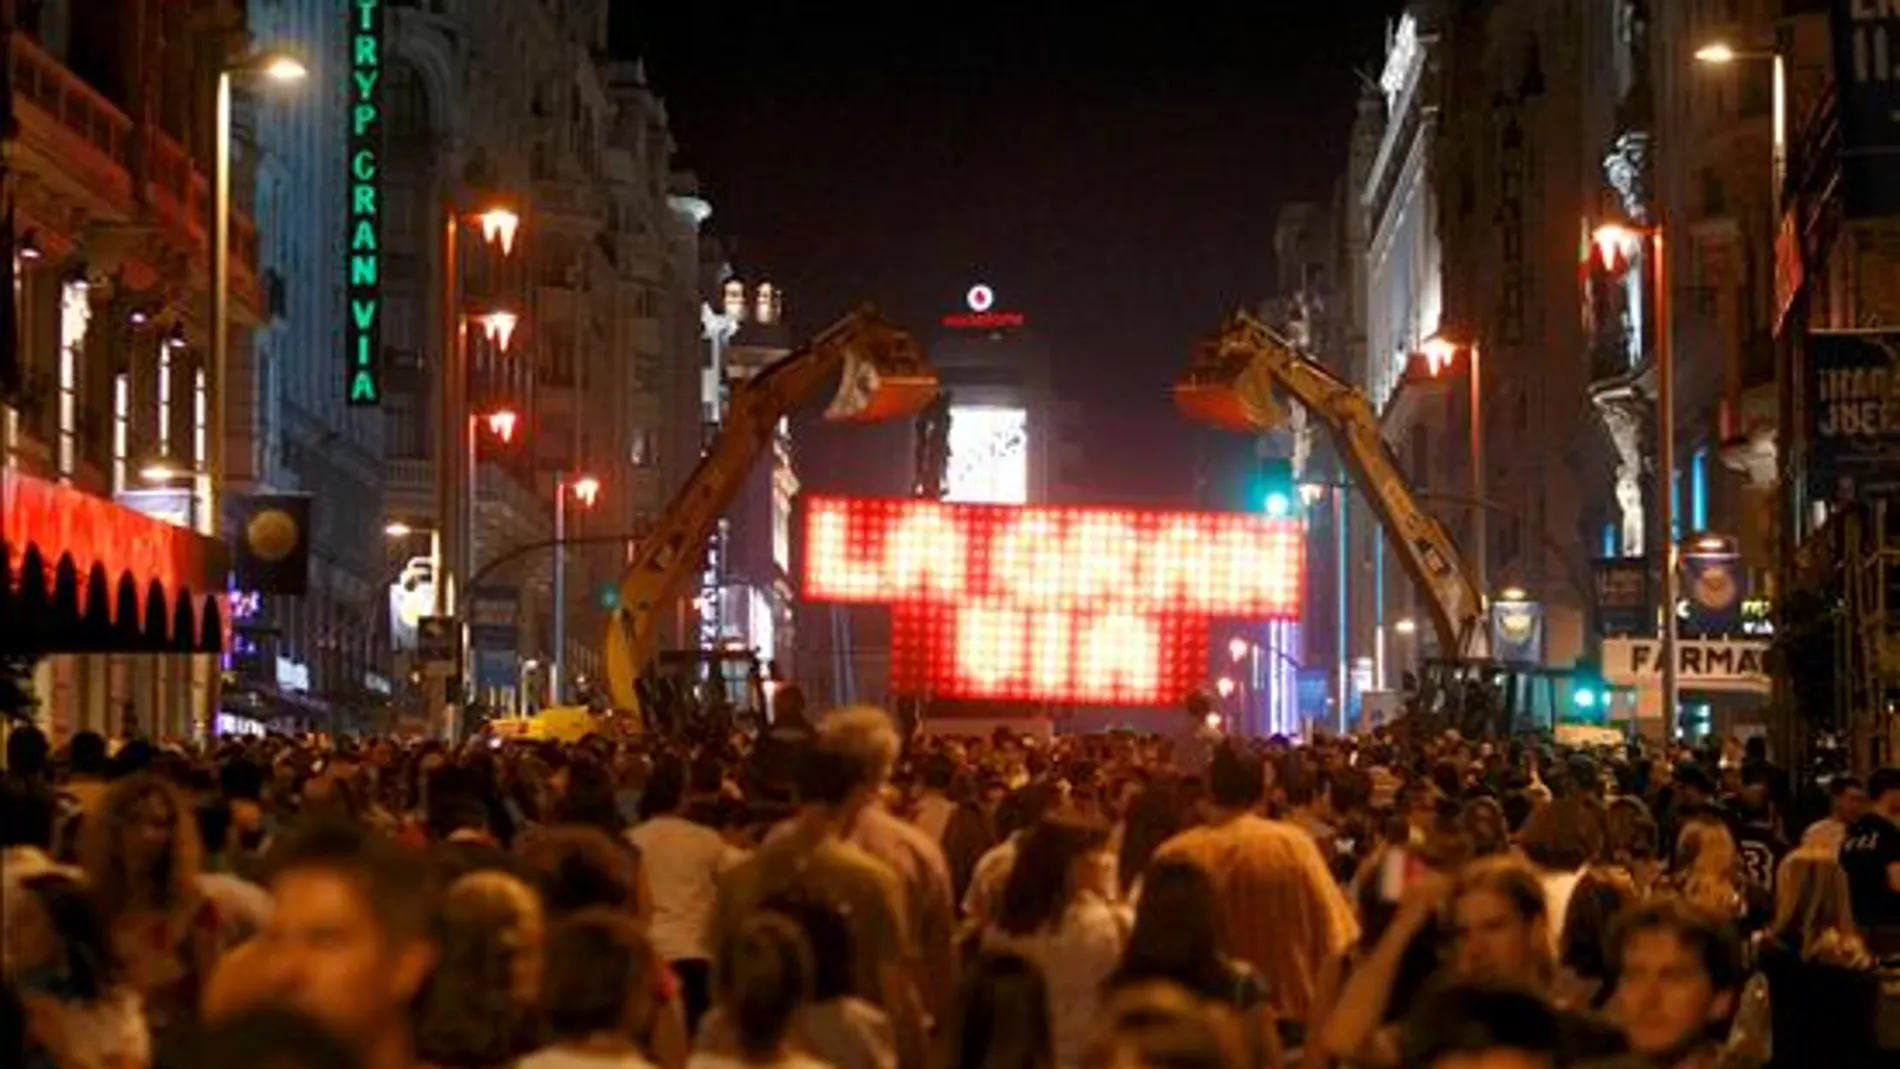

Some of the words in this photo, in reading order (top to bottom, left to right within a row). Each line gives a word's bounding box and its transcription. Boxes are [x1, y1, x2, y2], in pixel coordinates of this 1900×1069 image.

[354, 0, 379, 135] TRYP
[352, 300, 376, 400] VIA
[809, 505, 966, 598] LA
[988, 509, 1301, 613] GRAN
[1631, 646, 1770, 675] FRMA
